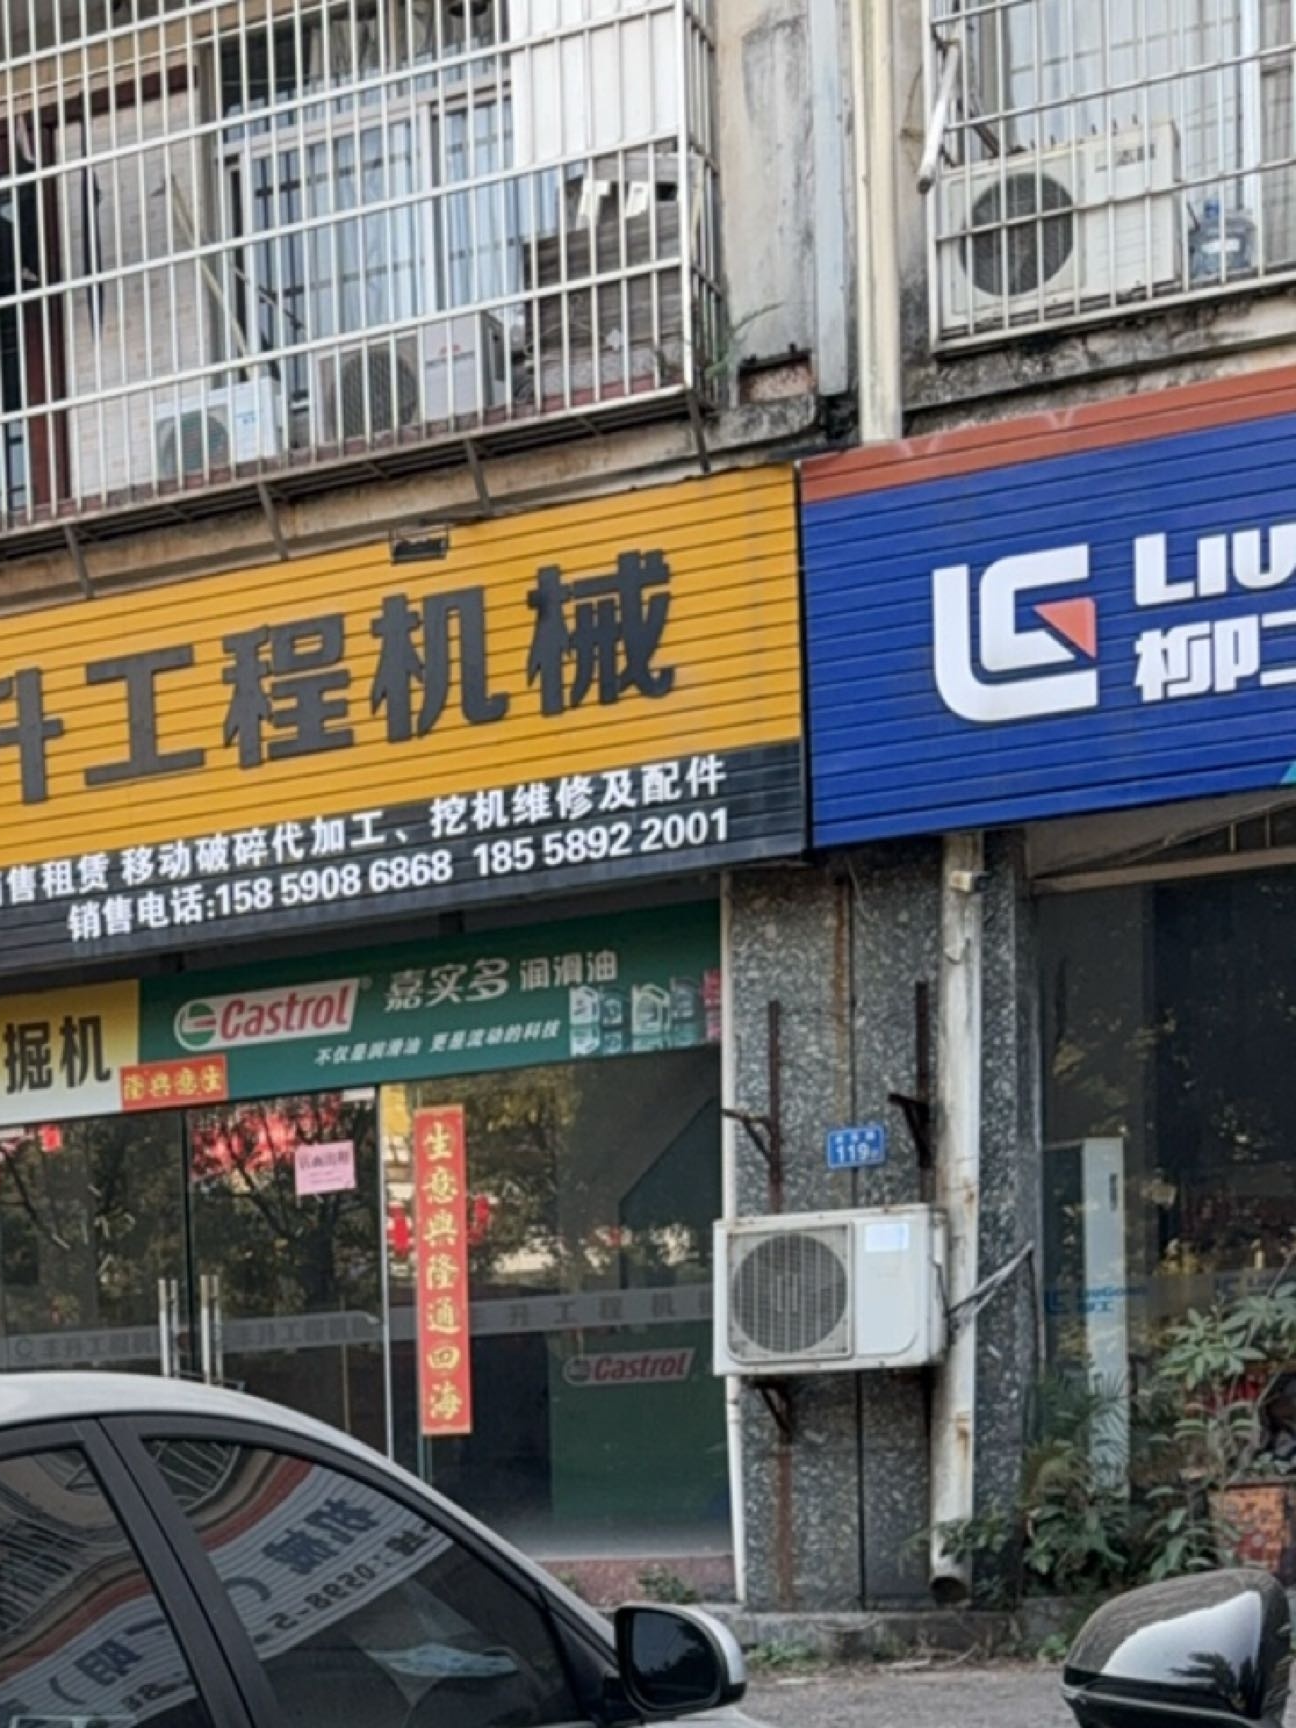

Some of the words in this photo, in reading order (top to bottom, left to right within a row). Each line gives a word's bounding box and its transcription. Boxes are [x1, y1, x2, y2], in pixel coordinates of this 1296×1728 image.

[1134, 610, 1296, 702] 柳
[281, 861, 362, 909] 5908
[368, 848, 453, 893] 6868
[472, 833, 535, 877] 185
[543, 820, 633, 865] 5892
[640, 806, 729, 849] 2001
[220, 983, 351, 1040] Castrol
[385, 957, 510, 1012] 嘉实多
[519, 949, 618, 992] 润滑油
[592, 1350, 689, 1382] Castrol
